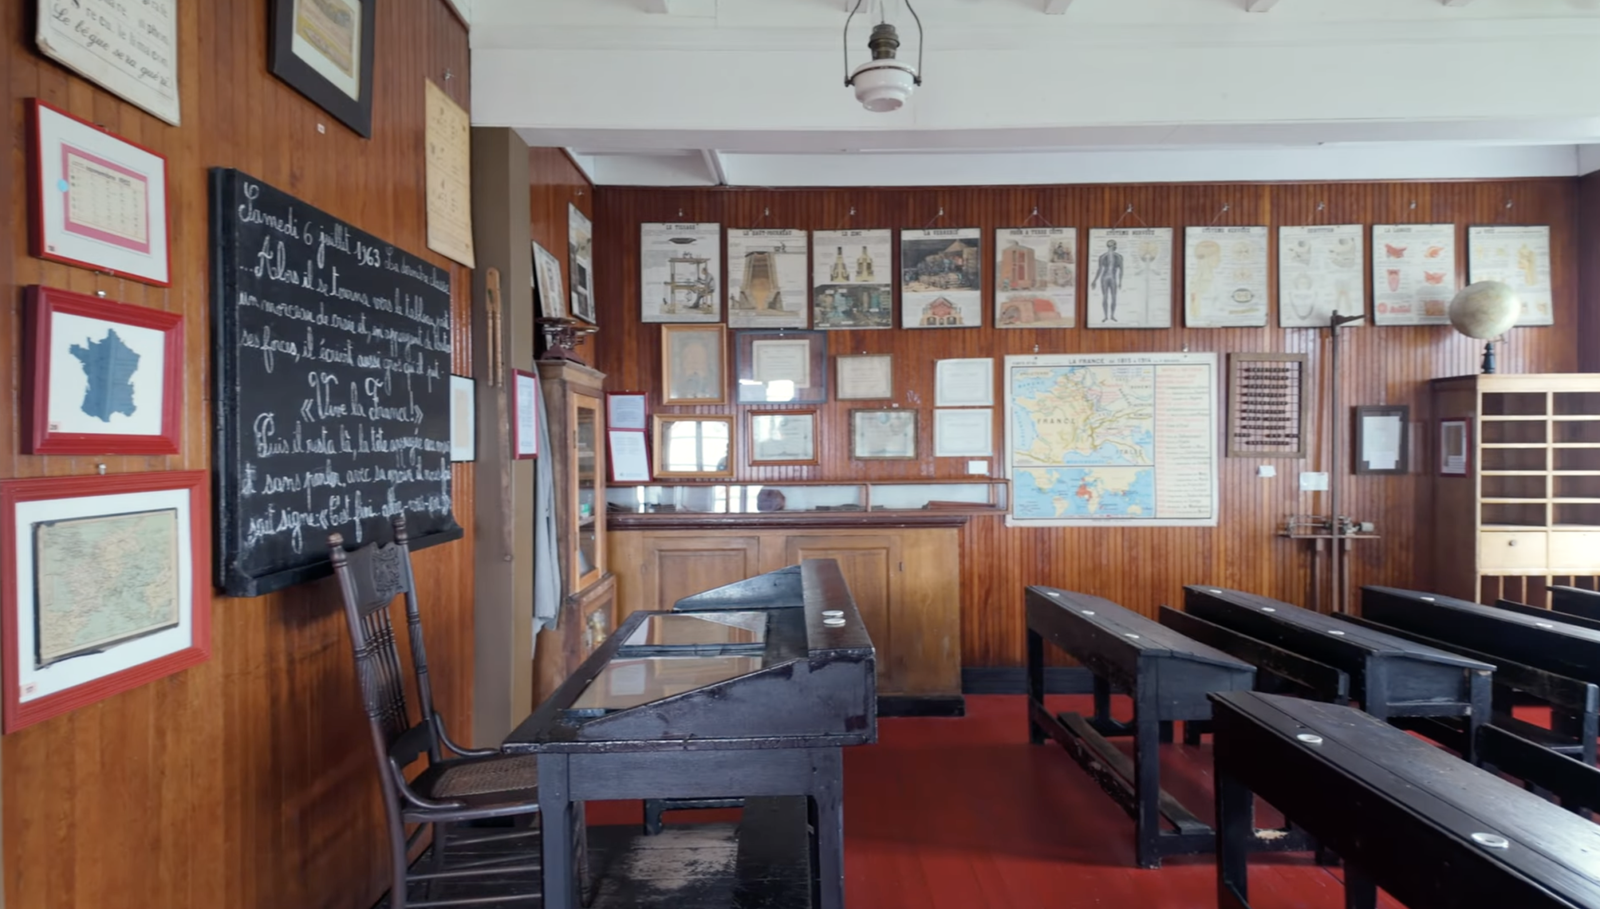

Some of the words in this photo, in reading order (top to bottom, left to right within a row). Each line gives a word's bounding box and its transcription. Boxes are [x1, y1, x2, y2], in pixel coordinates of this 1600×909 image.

[238, 181, 300, 240] Samedi
[303, 221, 314, 246] 6
[316, 223, 351, 269] juillet
[353, 241, 381, 268] 1963
[302, 259, 315, 291] il
[239, 291, 260, 309] un
[260, 299, 316, 324] morceau
[316, 301, 330, 327] de
[302, 326, 316, 360] il
[350, 381, 367, 418] la
[253, 412, 290, 458] Puis
[291, 420, 305, 453] il
[1037, 417, 1076, 425] FRANCE
[261, 473, 302, 495] sans
